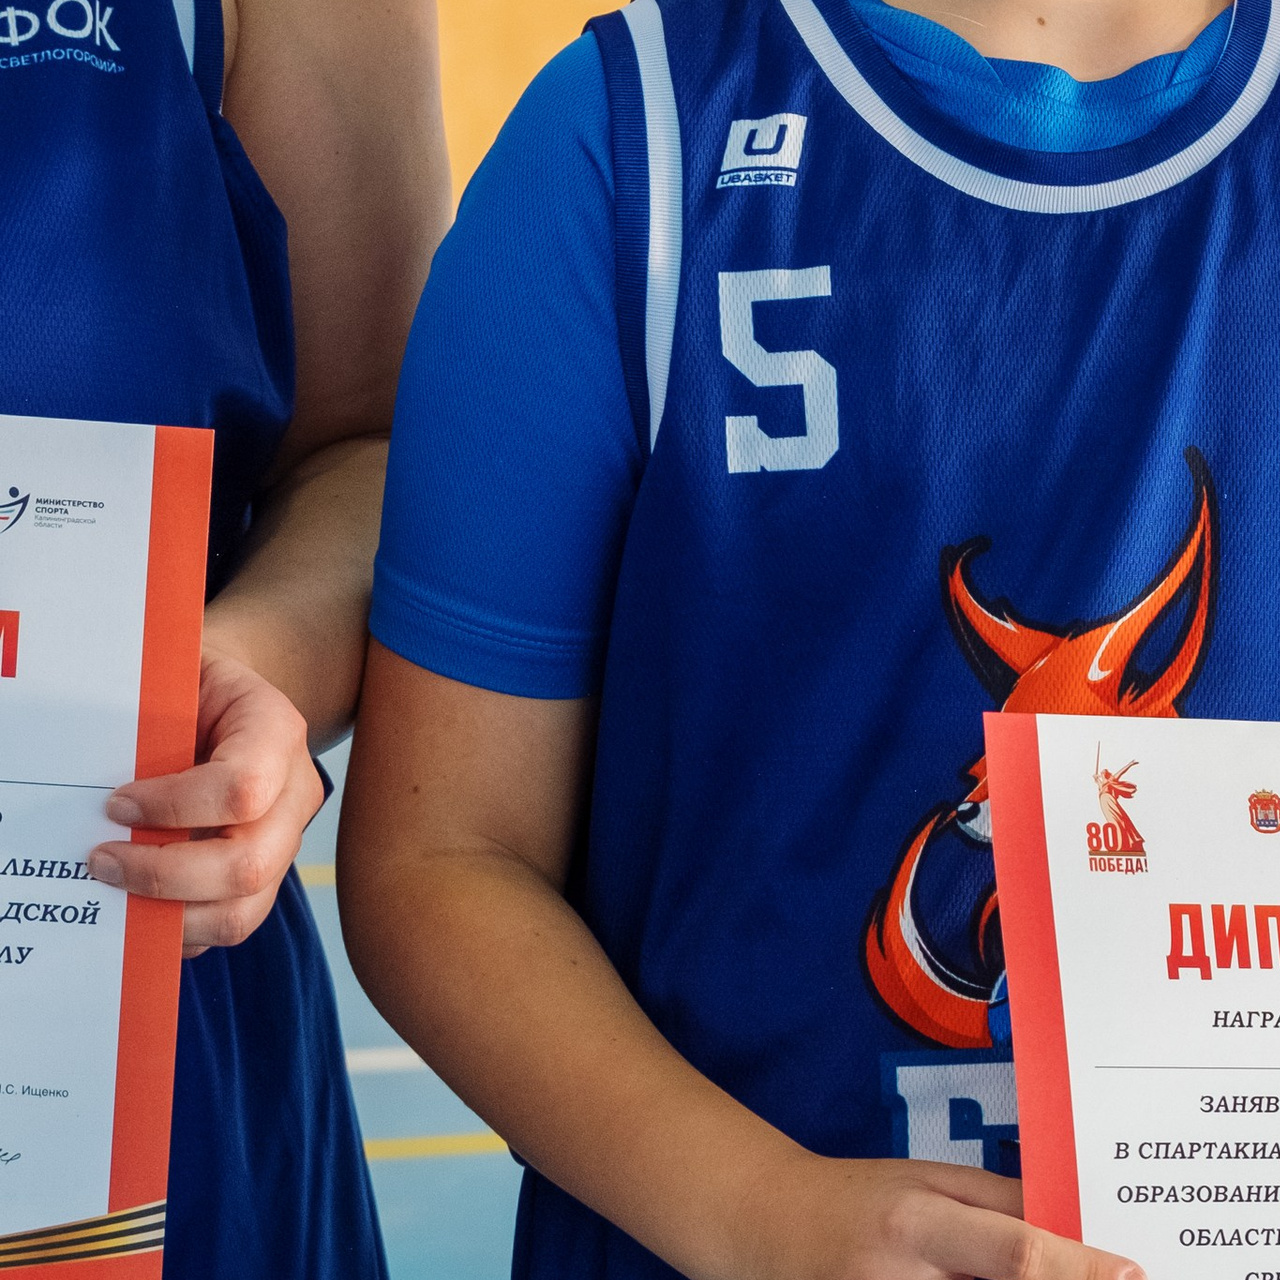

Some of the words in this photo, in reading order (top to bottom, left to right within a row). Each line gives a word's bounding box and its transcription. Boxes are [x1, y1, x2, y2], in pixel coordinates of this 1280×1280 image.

[743, 124, 788, 155] U
[720, 172, 794, 186] UBASKET
[718, 265, 840, 474] 5
[35, 498, 105, 509] МИНИСТЕРСТВО
[35, 506, 69, 515] СПОРТА
[34, 515, 96, 524] Калининградской
[1086, 822, 1118, 852] 80
[1088, 857, 1149, 875] ПОБЕДА!
[22, 1085, 69, 1098] Ищенко
[1114, 1141, 1131, 1160] В
